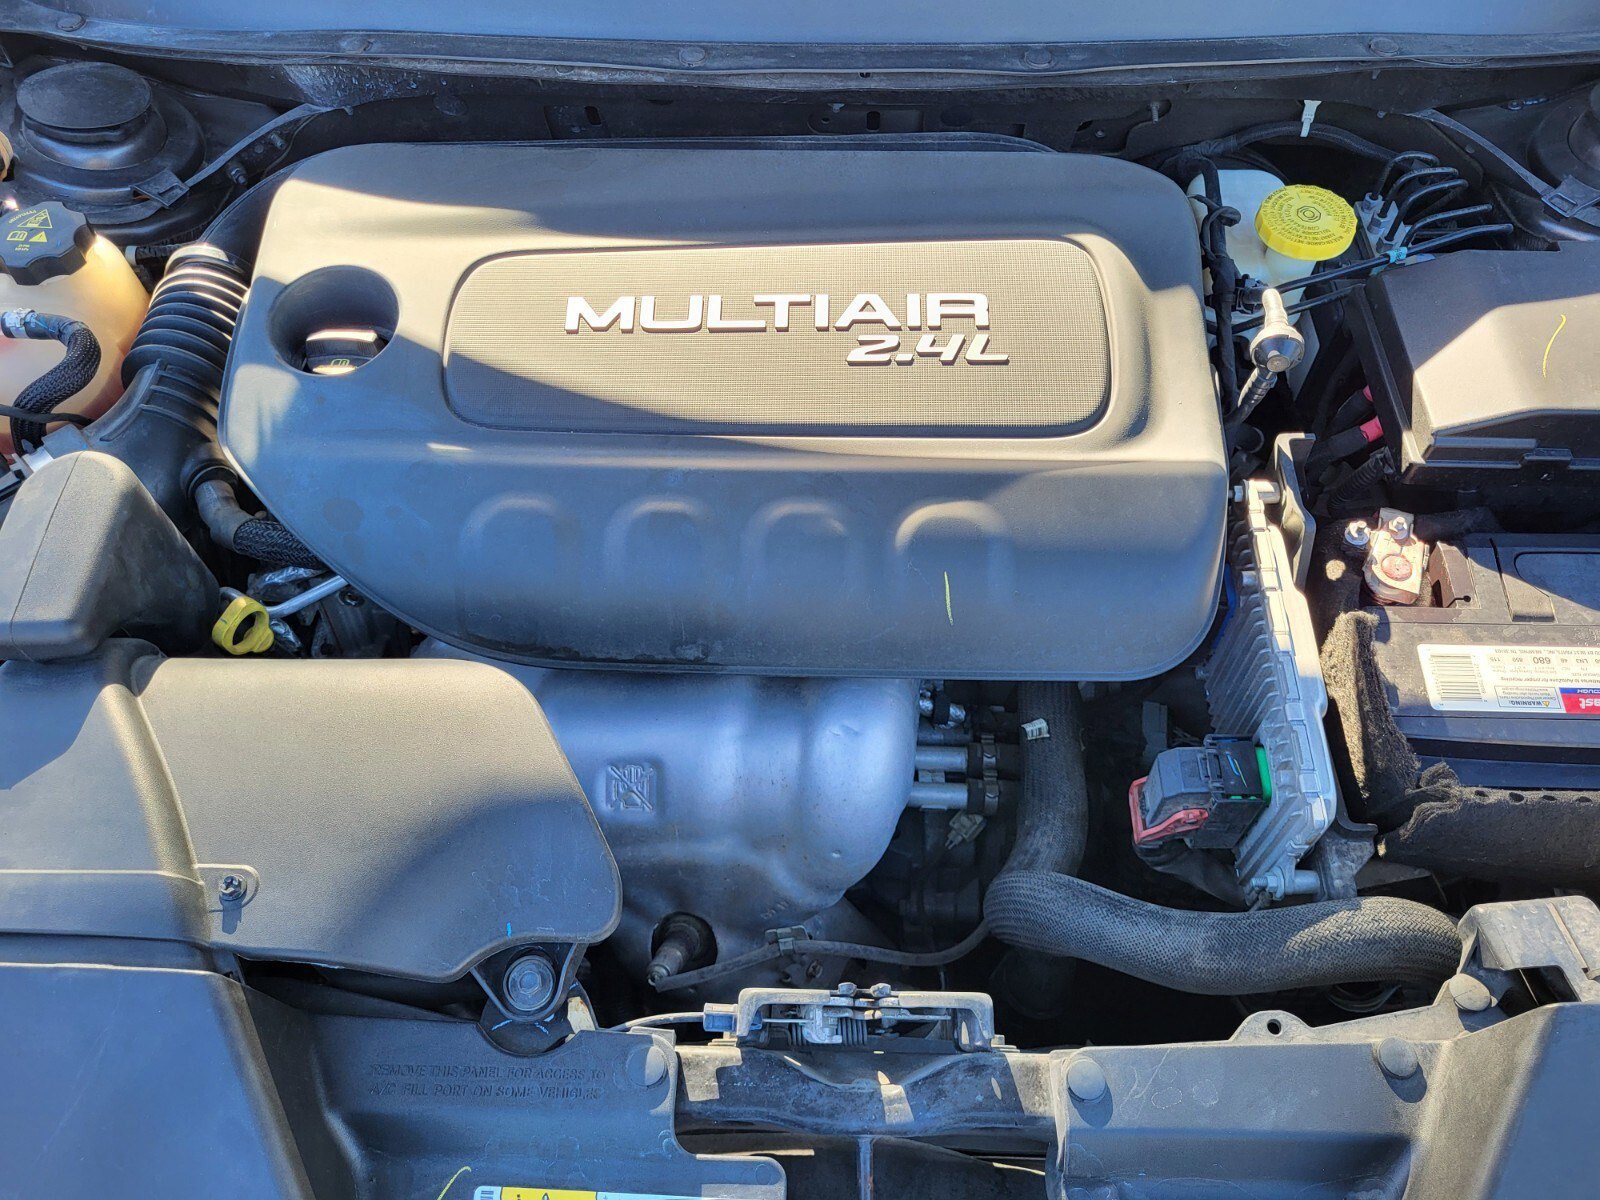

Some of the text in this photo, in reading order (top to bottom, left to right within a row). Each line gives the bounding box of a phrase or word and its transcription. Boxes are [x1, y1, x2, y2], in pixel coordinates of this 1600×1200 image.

[564, 293, 990, 333] MULTIAIR
[846, 333, 1009, 366] 2.4L
[1533, 656, 1551, 665] 680
[370, 1063, 606, 1081] REMOVE THIS PANEL FOR ACCESS TO
[368, 1081, 602, 1100] A/C FILL PORT ON SOME VEHICLES
